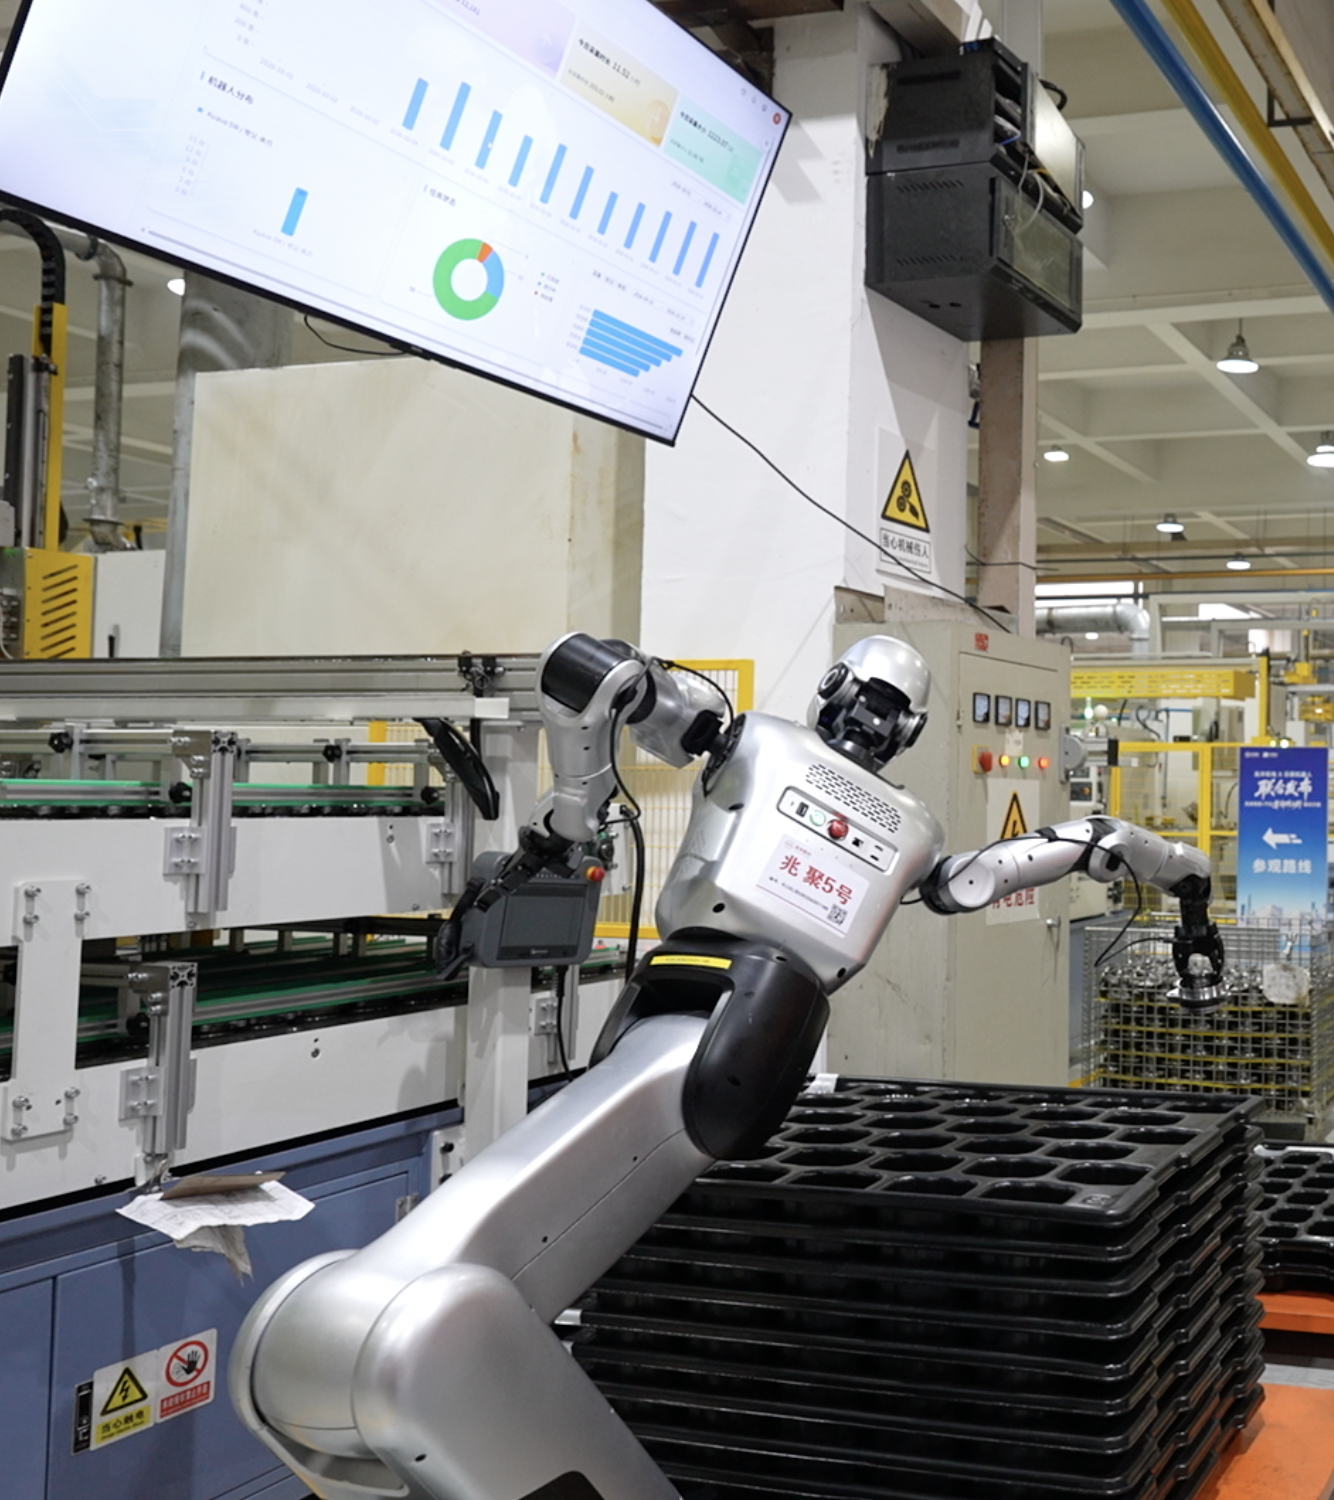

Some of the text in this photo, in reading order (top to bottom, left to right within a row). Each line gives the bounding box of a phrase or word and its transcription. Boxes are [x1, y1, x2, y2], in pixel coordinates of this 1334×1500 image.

[208, 75, 254, 104] 机器人分布
[882, 533, 929, 558] 当心机械伤人
[1252, 858, 1312, 874] 参观路线
